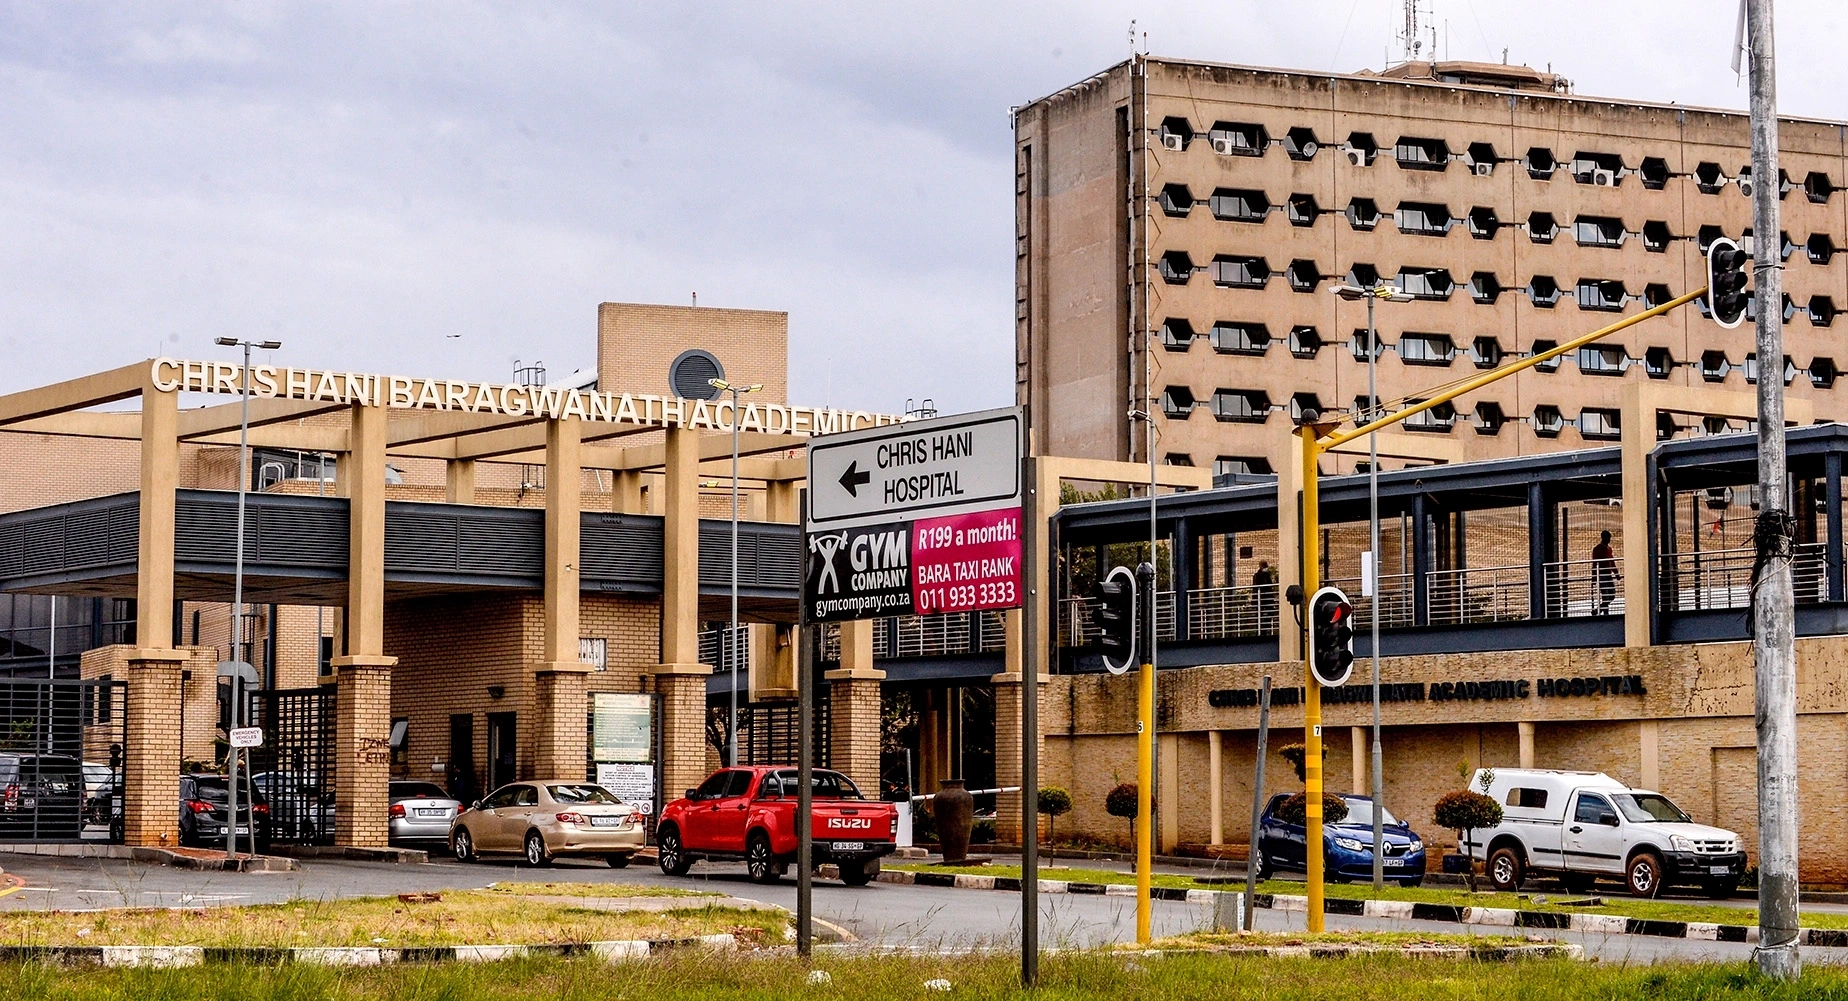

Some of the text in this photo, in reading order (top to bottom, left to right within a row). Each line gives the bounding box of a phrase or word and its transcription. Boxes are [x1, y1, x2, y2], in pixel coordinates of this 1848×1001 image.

[151, 357, 871, 437] CHRS HANI BARAGWANATH ACADEMIC
[877, 431, 973, 469] CHRIS HANI
[884, 470, 964, 504] HOSPITAL
[918, 517, 1016, 550] R199 a month!
[850, 530, 907, 572] GYM
[851, 568, 907, 591] COMPANY
[918, 556, 1014, 585] BARA TAXI RANK
[816, 592, 910, 618] gymcompany.co.za
[920, 581, 1015, 610] 011 933 3333
[1428, 679, 1530, 701] ACADEMIC
[1537, 675, 1648, 698] HOSPITAL
[1315, 726, 1320, 735] 7
[828, 818, 871, 829] ISUZU
